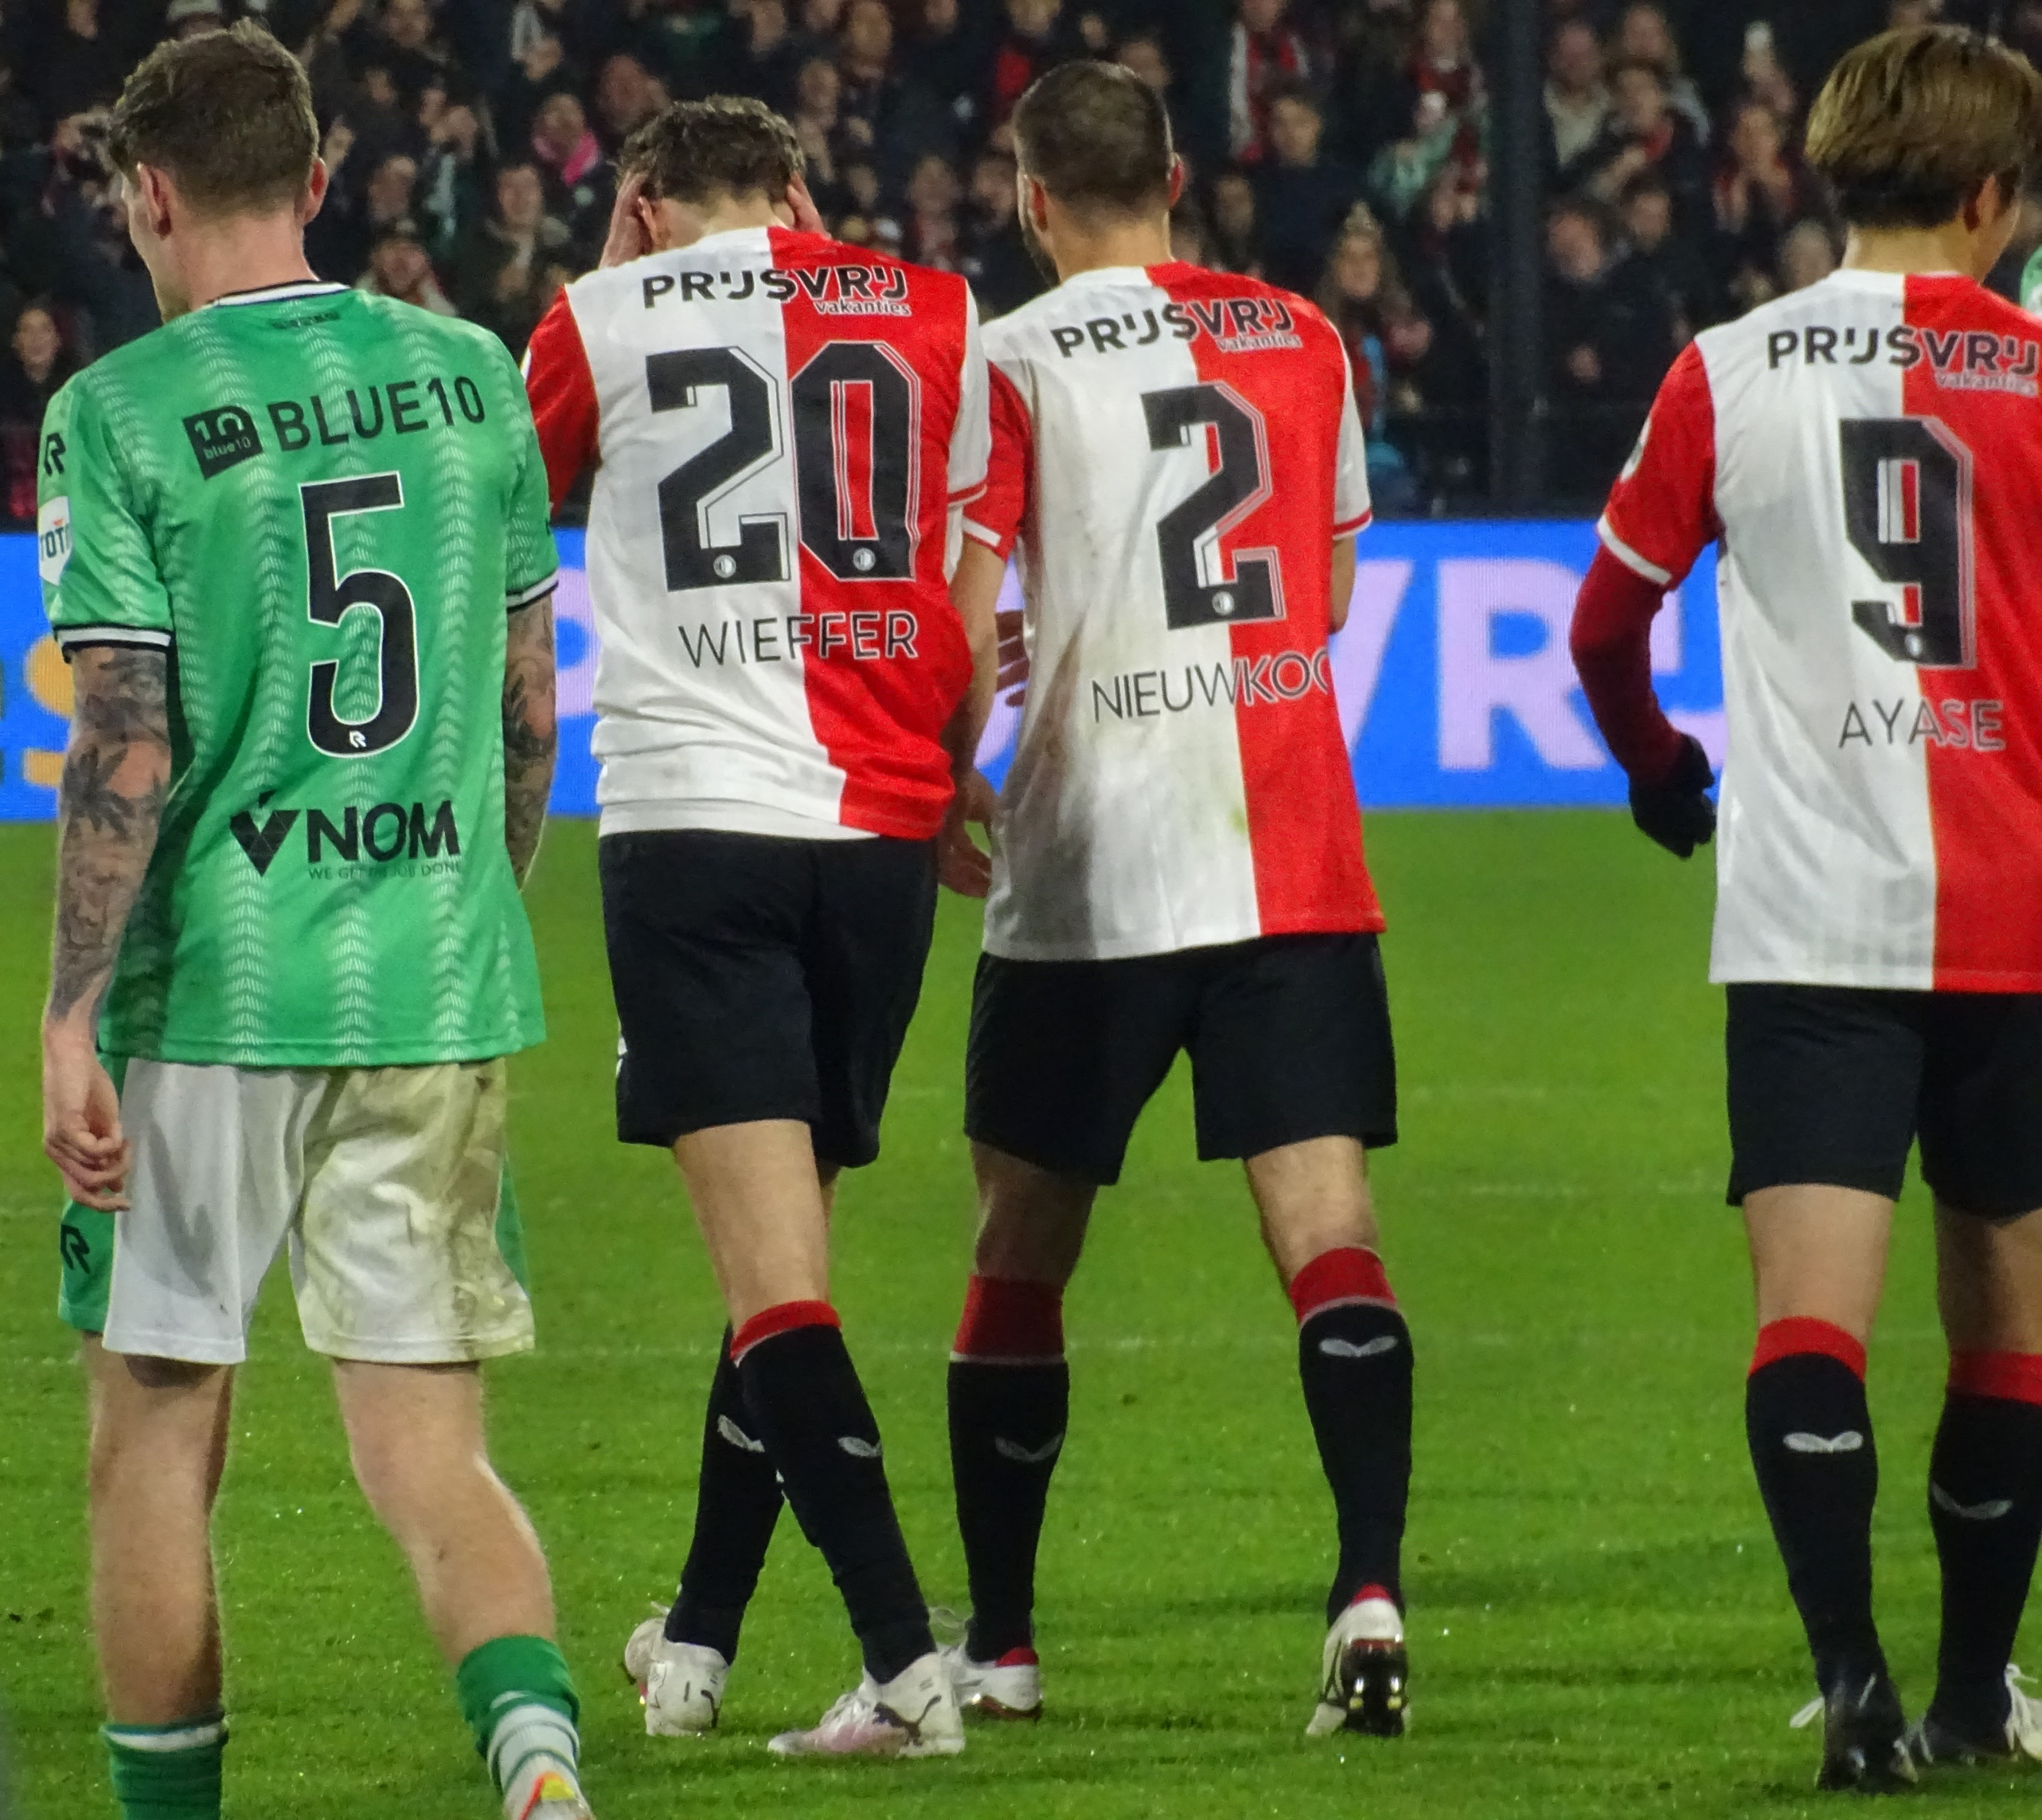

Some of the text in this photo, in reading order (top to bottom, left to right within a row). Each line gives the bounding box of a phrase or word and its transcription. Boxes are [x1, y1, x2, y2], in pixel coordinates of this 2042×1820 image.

[814, 298, 913, 317] vakanties
[203, 436, 252, 460] blue10
[267, 375, 485, 452] BLUE10
[645, 339, 921, 592] 20
[1141, 380, 1286, 631] 2
[1838, 415, 1977, 670] 9
[297, 470, 420, 758] 5
[677, 610, 918, 669] WIEFFER
[1838, 698, 2006, 752] AYASE
[306, 800, 461, 864] NOM
